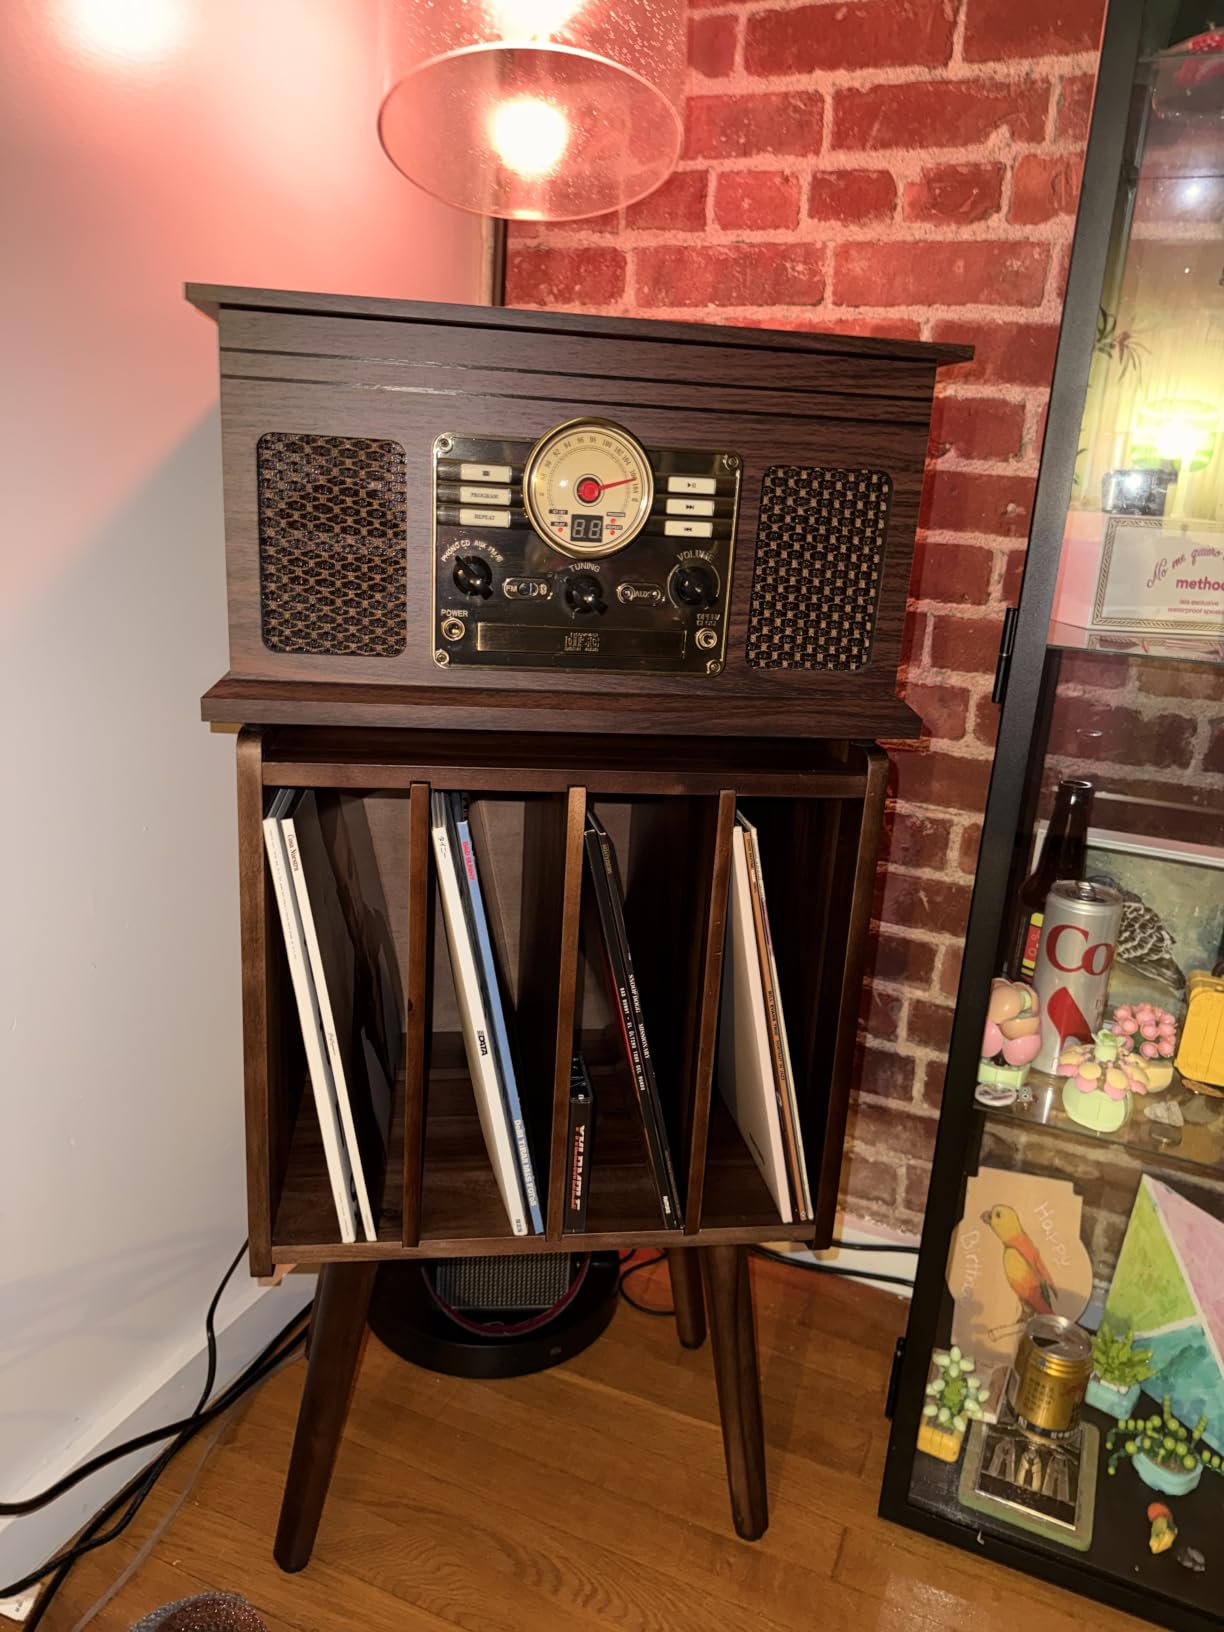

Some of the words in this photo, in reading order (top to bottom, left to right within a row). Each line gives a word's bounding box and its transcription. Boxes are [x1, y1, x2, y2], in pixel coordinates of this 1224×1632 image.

[474, 513, 496, 521] REPEAT
[441, 541, 460, 562] PHONO
[474, 540, 487, 550] AUX
[676, 549, 715, 563] VOLUME
[569, 562, 601, 573] TUNING
[506, 584, 518, 593] FM
[441, 608, 469, 618] POWER
[628, 974, 638, 995] SNOOP
[639, 1023, 650, 1059] MISSIONARY
[478, 1035, 488, 1057] DATA
